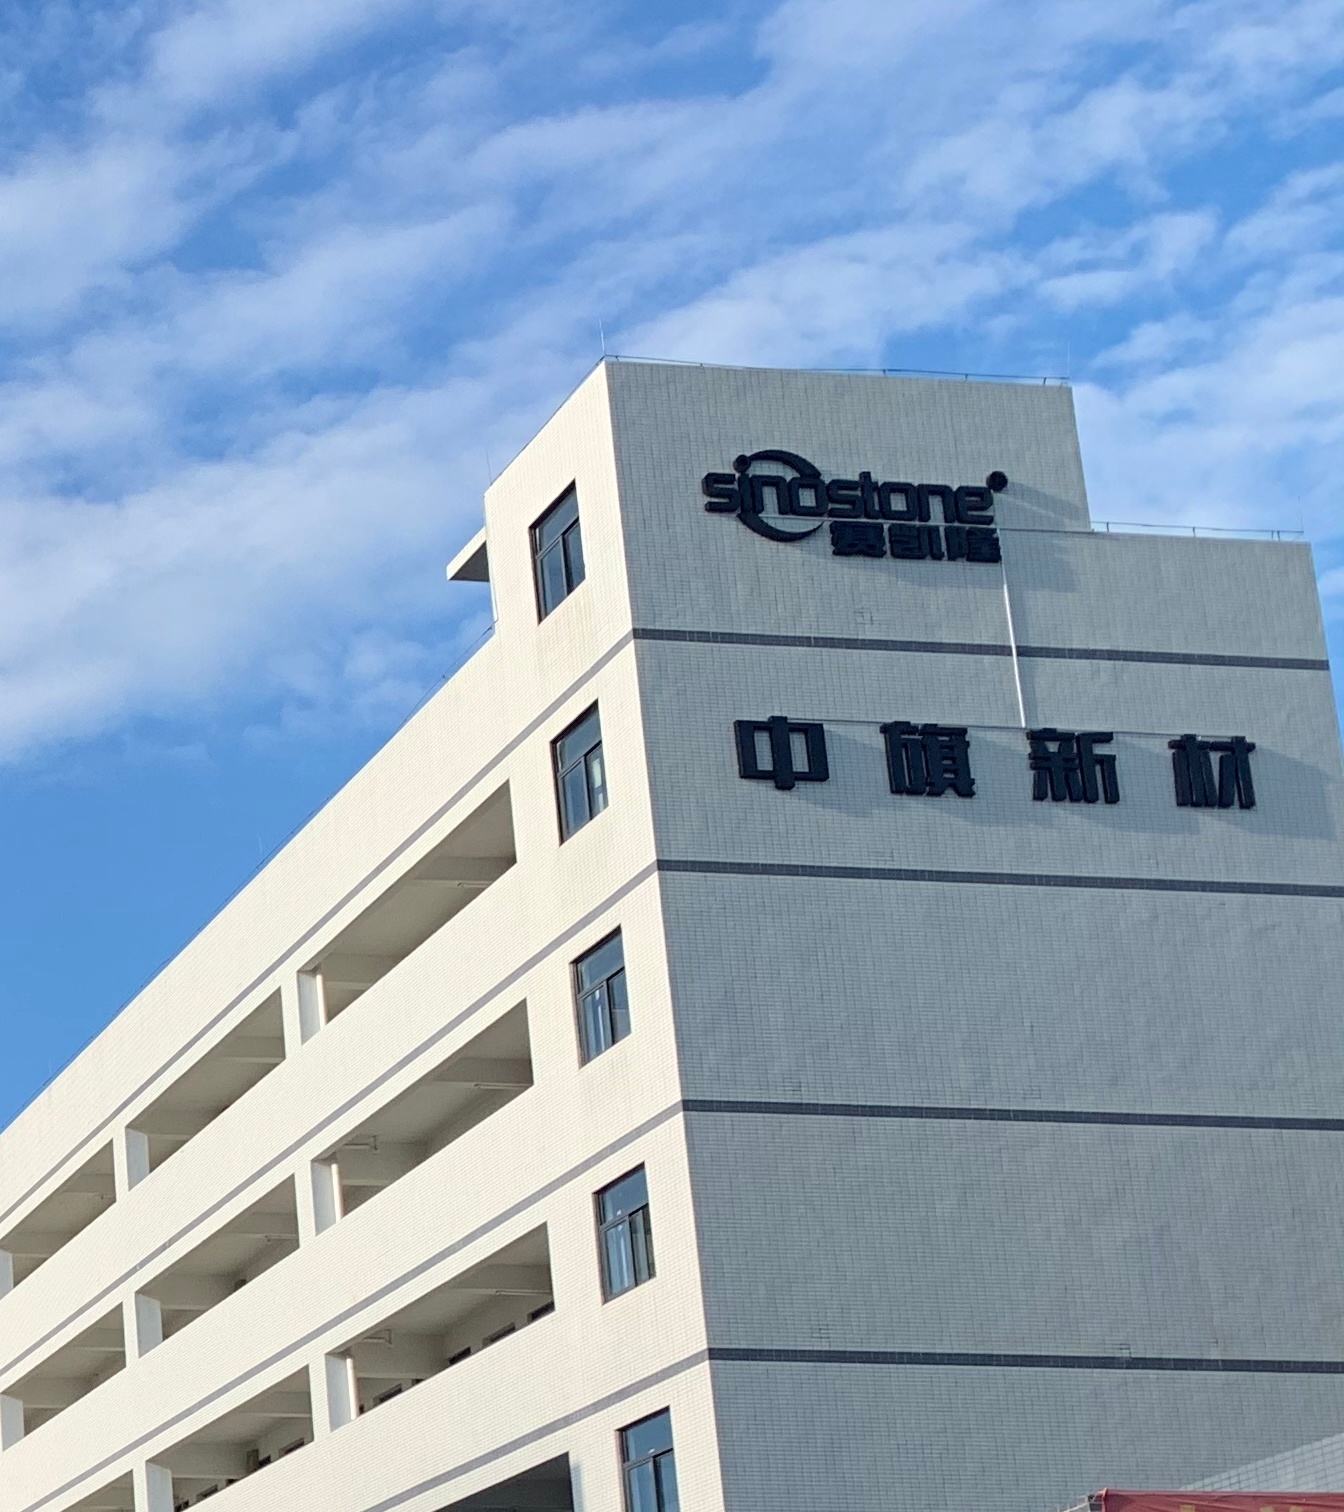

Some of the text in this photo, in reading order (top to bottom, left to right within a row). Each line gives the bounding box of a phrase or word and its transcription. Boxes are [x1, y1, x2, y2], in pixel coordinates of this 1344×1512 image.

[829, 520, 1003, 563] 赛凯隆
[733, 715, 1256, 809] 中旗新材
